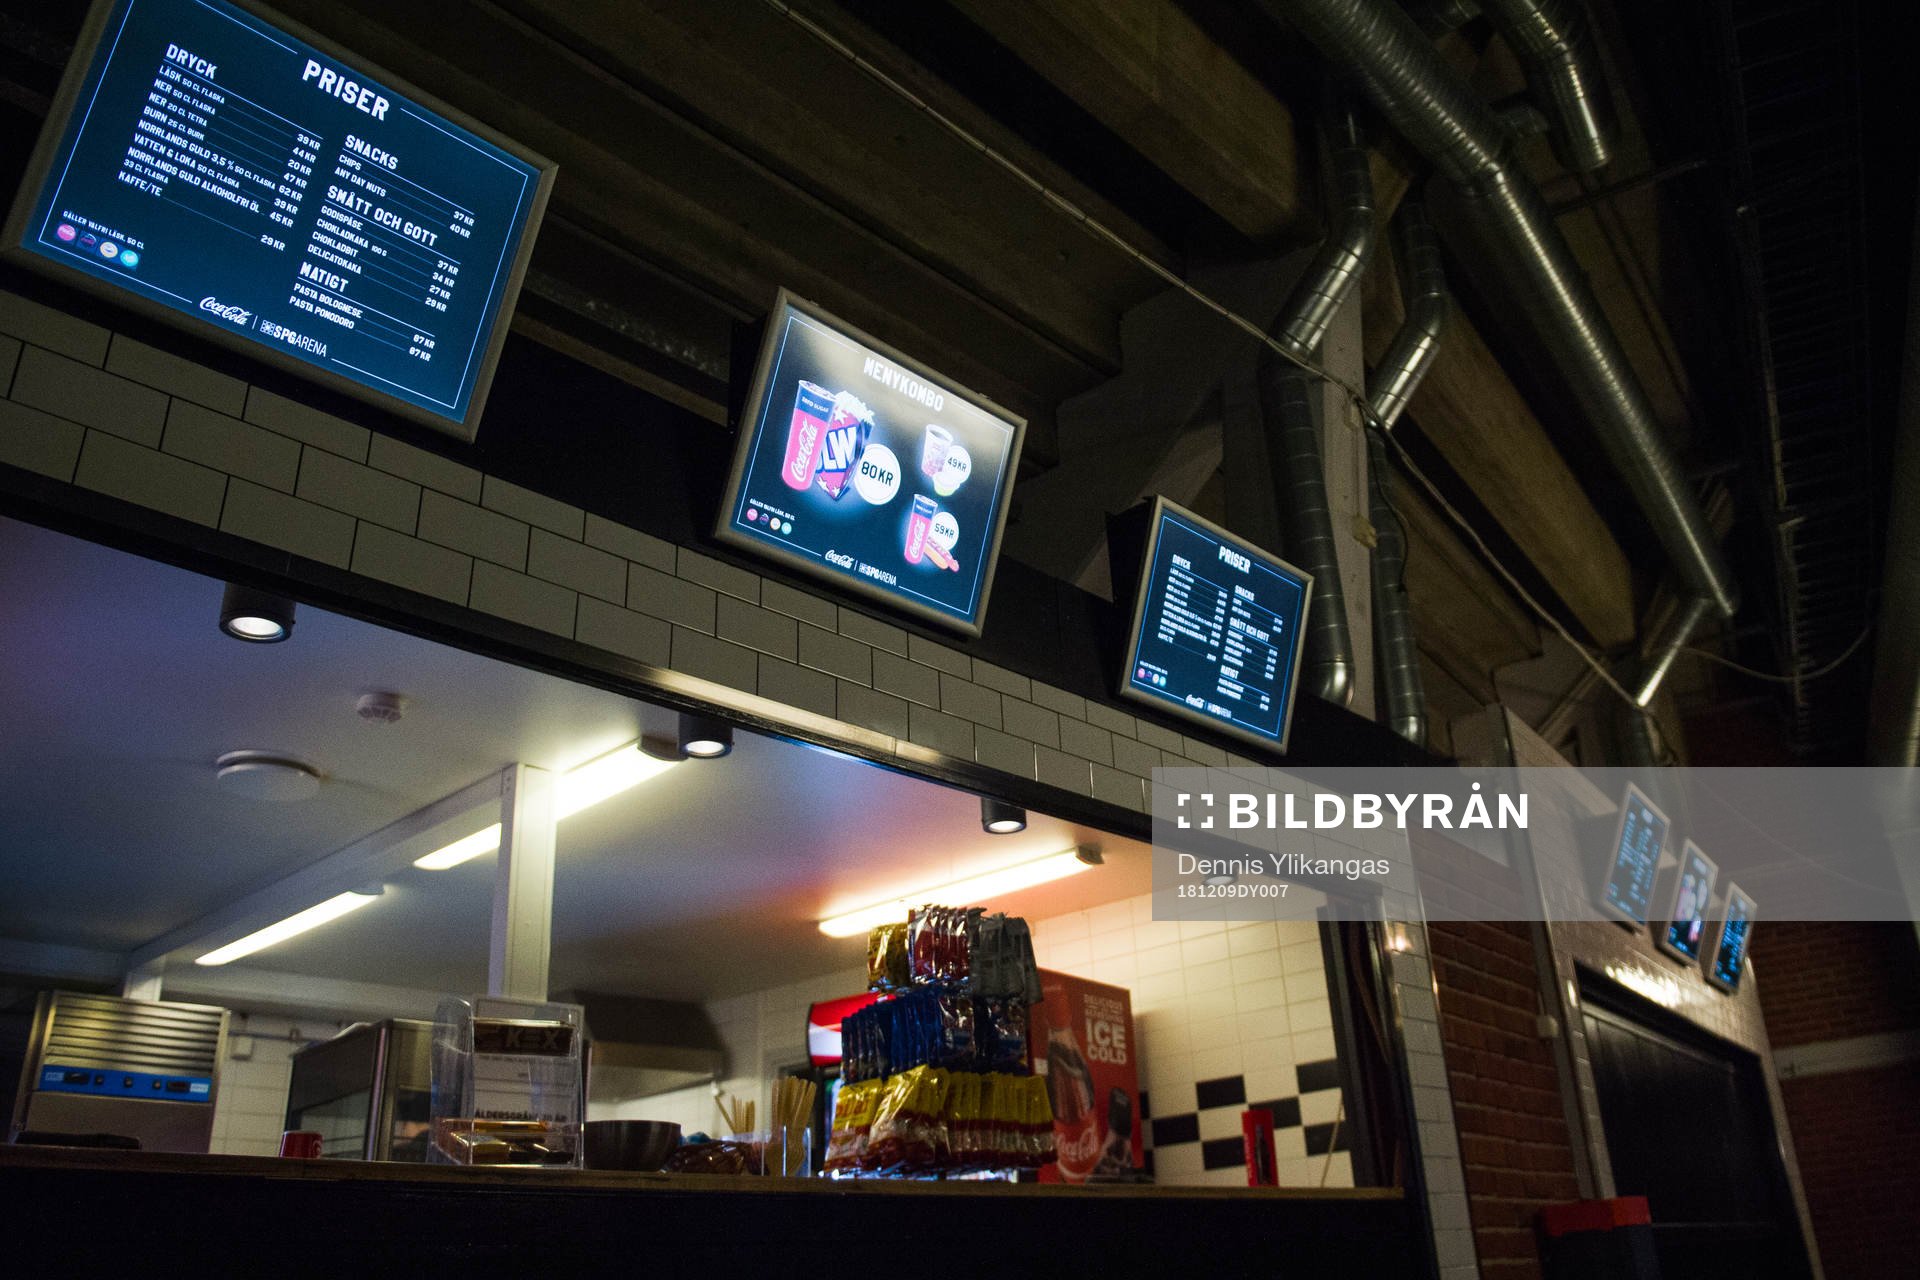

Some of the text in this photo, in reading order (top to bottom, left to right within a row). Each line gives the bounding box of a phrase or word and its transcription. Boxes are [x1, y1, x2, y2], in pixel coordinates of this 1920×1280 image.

[167, 44, 216, 79] DRYCK
[154, 79, 215, 115] MER 50 CL FLASKA
[159, 65, 225, 104] LÄSK 50 CL FLASKA
[302, 58, 390, 121] PRISER
[144, 106, 204, 141] BURN 25 CL BURK
[149, 92, 207, 127] MER 20 CL TETRA
[293, 147, 305, 158] 44
[297, 134, 309, 145] 39
[345, 135, 398, 169] SNACKS
[135, 133, 239, 188] VATTEN & LOKA 50 CL FLASKA
[139, 120, 276, 190] NORRLANDS GULD 3,5 % 50 CL FLASKA
[288, 159, 300, 170] 20
[339, 155, 362, 171] CHIPS
[119, 171, 162, 196] KAFFE/TE
[124, 159, 168, 184] 33 CL FLASKA
[128, 147, 259, 213] NORRLANDS GULD ALKOHOLFRI ÖL
[284, 173, 296, 183] 47
[335, 167, 386, 197] ANY DAY NUTS
[274, 198, 287, 209] 39
[279, 185, 291, 196] 62
[270, 212, 294, 228] 45 KR
[321, 206, 363, 230] GODISPÅSE
[328, 186, 437, 246] SMÅTT OCH GOTT
[261, 235, 274, 246] 29
[312, 232, 358, 257] CHOKLADBIT
[317, 219, 368, 248] CHOKLADKAKA
[308, 244, 361, 274] DELICATOKAKA
[300, 262, 348, 292] MATIGT
[429, 285, 441, 295] 27
[432, 272, 443, 282] 34
[289, 296, 354, 329] PASTA POMODORO
[294, 283, 363, 318] PASTA BOLOGNESE
[425, 297, 437, 307] 29
[863, 357, 944, 412] MENYKOMBO
[817, 426, 857, 471] LW
[947, 456, 958, 468] 49
[861, 461, 894, 487] 80 KR
[934, 523, 945, 534] 59
[1218, 545, 1251, 574] PRISER
[1085, 1017, 1126, 1049] ICE
[1087, 1045, 1127, 1065] COLD
